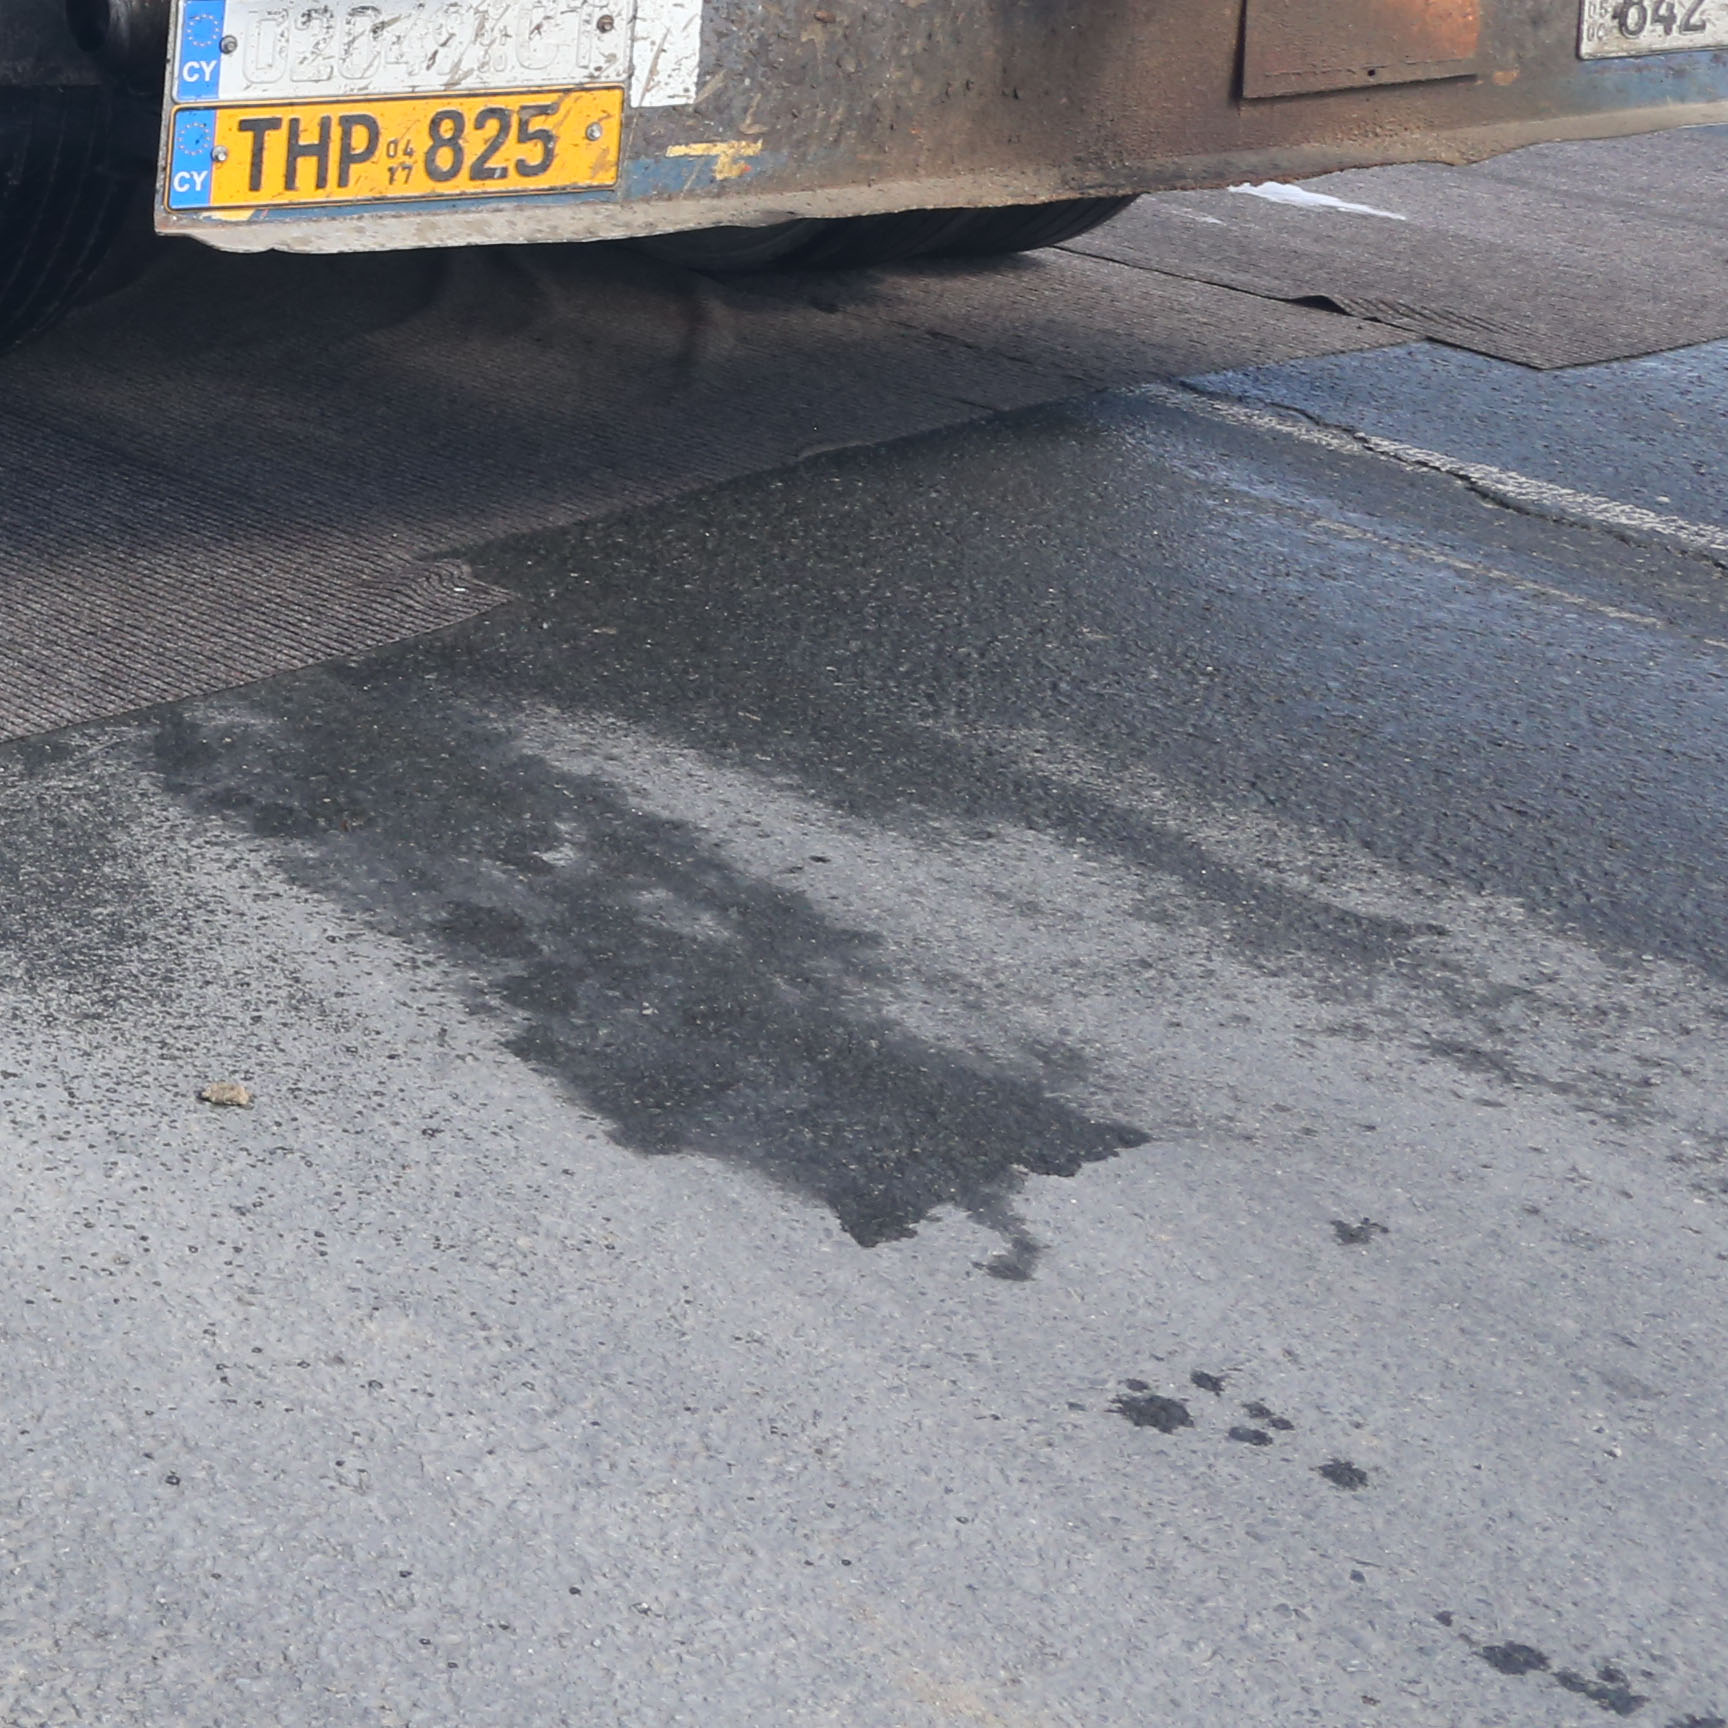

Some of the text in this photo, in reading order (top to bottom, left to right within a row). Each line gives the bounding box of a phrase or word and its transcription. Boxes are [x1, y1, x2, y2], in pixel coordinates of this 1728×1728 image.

[183, 60, 217, 83] CY
[238, 101, 559, 192] THP 825
[173, 170, 209, 192] CY
